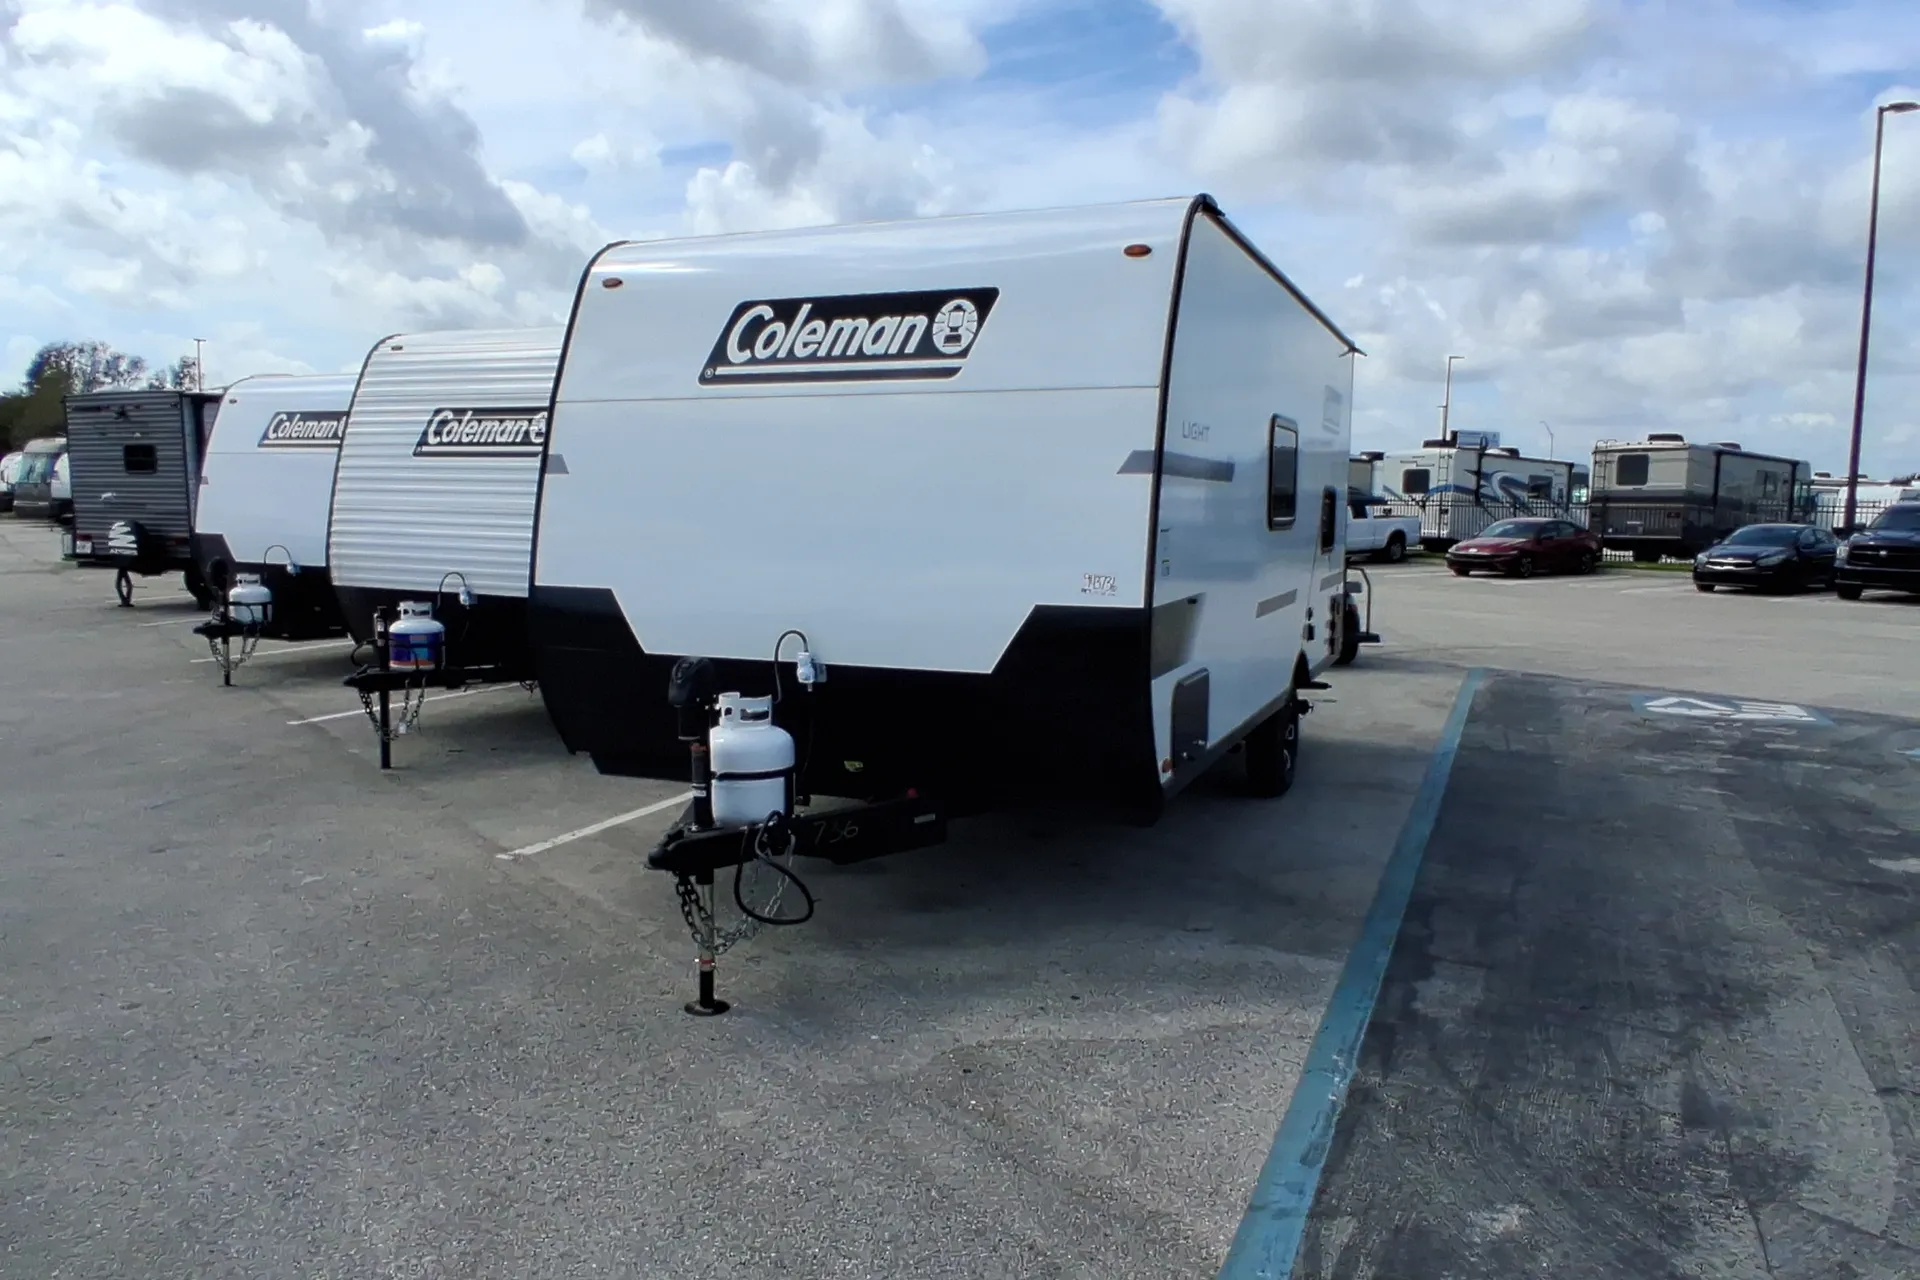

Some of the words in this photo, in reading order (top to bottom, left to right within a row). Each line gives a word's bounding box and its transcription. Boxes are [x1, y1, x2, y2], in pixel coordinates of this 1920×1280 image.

[726, 304, 928, 364] Coleman
[268, 413, 338, 440] Coleman
[428, 410, 529, 445] Coleman
[1182, 419, 1211, 443] LIGHT
